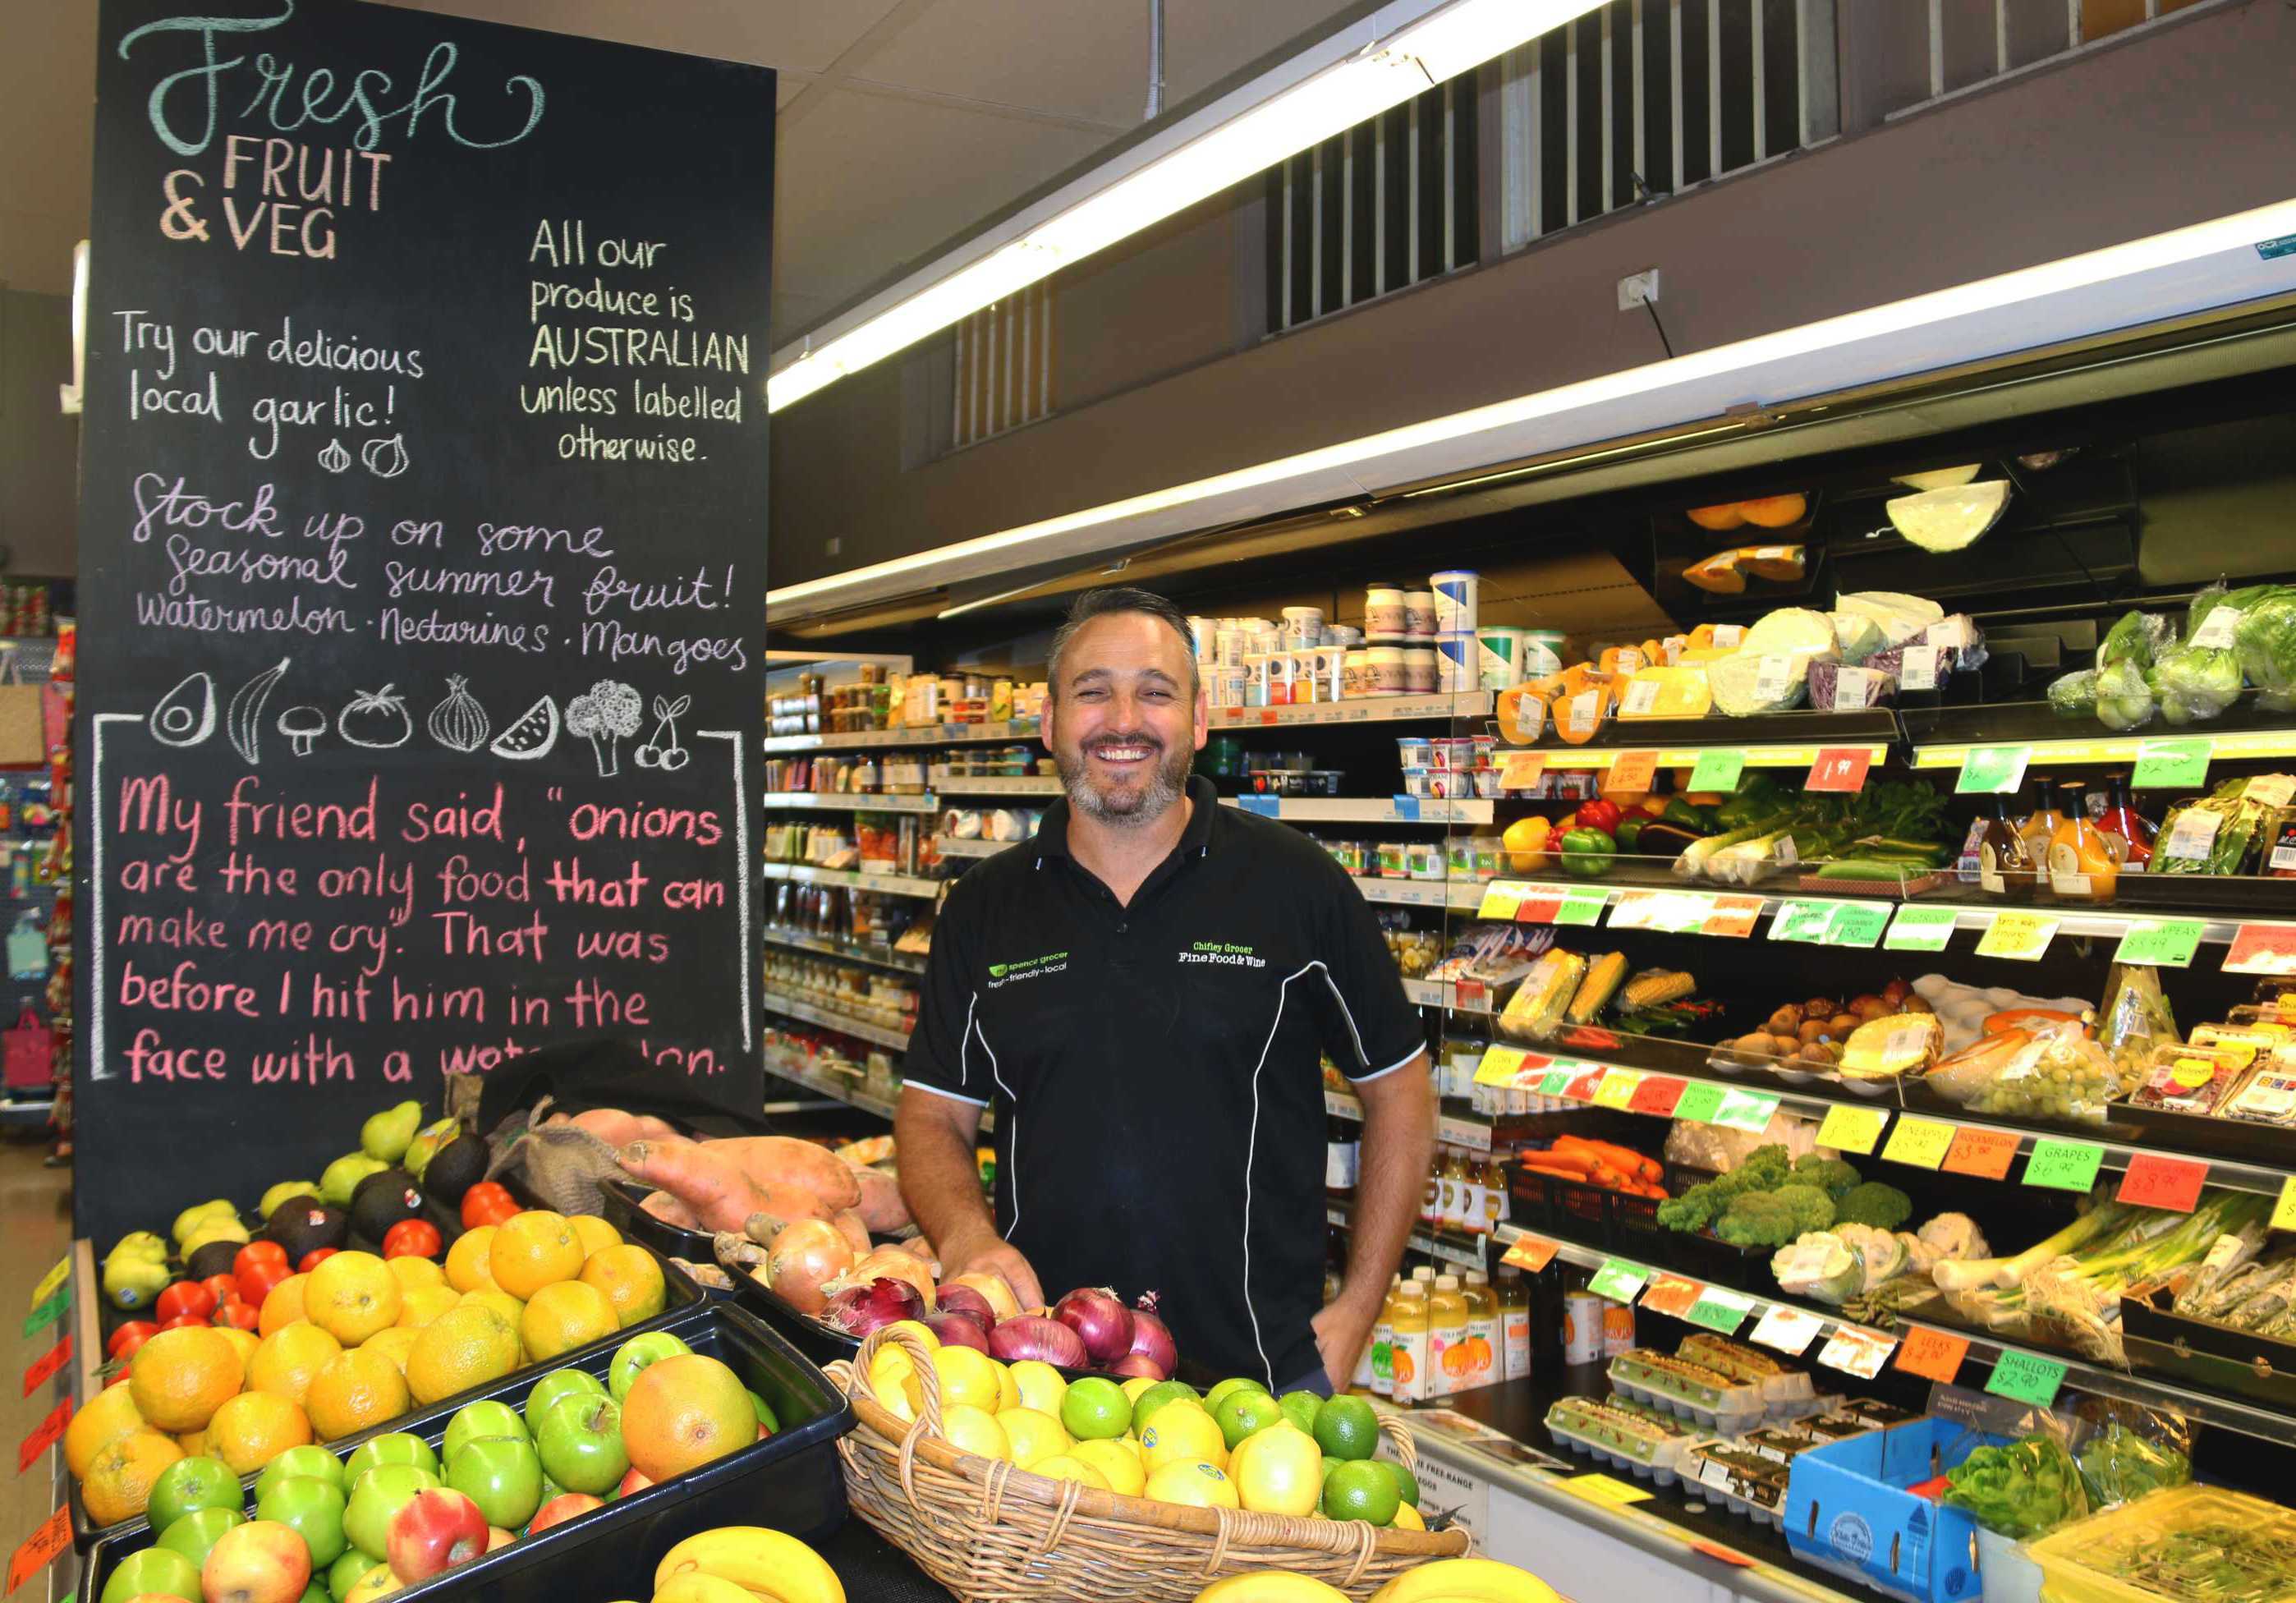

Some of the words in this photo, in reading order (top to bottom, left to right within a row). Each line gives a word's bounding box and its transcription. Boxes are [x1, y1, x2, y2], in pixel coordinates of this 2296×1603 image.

[117, 0, 546, 156] Fresh
[223, 134, 392, 211] FRUIT
[159, 169, 210, 242] &
[223, 194, 335, 260] VEG
[530, 218, 585, 267] All
[598, 239, 666, 269] our
[531, 280, 658, 323] produce
[669, 287, 694, 321] is
[113, 309, 173, 379] Try
[194, 328, 259, 357] our
[267, 316, 424, 379] delicious
[529, 324, 749, 374] AUSTRALIAN
[131, 369, 223, 422] local
[521, 383, 617, 415] unless
[635, 382, 742, 424] labelled
[558, 430, 707, 462] otherwise.
[133, 472, 283, 543] Stock
[304, 513, 364, 560] up
[392, 520, 443, 548] on
[478, 523, 613, 558] some
[584, 564, 733, 616] fruit!
[118, 774, 202, 866] My
[224, 775, 378, 846] friend
[121, 858, 197, 893] are
[218, 856, 297, 895] the
[318, 858, 414, 920] only
[436, 854, 530, 903] food
[544, 860, 648, 907] that
[664, 880, 724, 910] can
[118, 914, 227, 948] make
[248, 920, 312, 951] me
[432, 911, 549, 962] That
[576, 931, 669, 962] was
[1178, 952, 1208, 962] Fine
[1208, 952, 1236, 965] Food
[1237, 954, 1245, 966] &
[1246, 955, 1265, 967] Wine
[1193, 941, 1223, 953] Chifley
[1224, 943, 1253, 954] Grocer
[120, 960, 259, 1017] before
[281, 971, 291, 1014] I
[312, 972, 371, 1022] hit
[393, 978, 484, 1023] him
[511, 986, 549, 1026] in
[566, 978, 650, 1028] the
[122, 1027, 226, 1083] face
[252, 1033, 355, 1086] with
[383, 1051, 413, 1082] a
[2044, 1147, 2091, 1163] GRAPES
[2003, 1355, 2060, 1380] SHALLOTS
